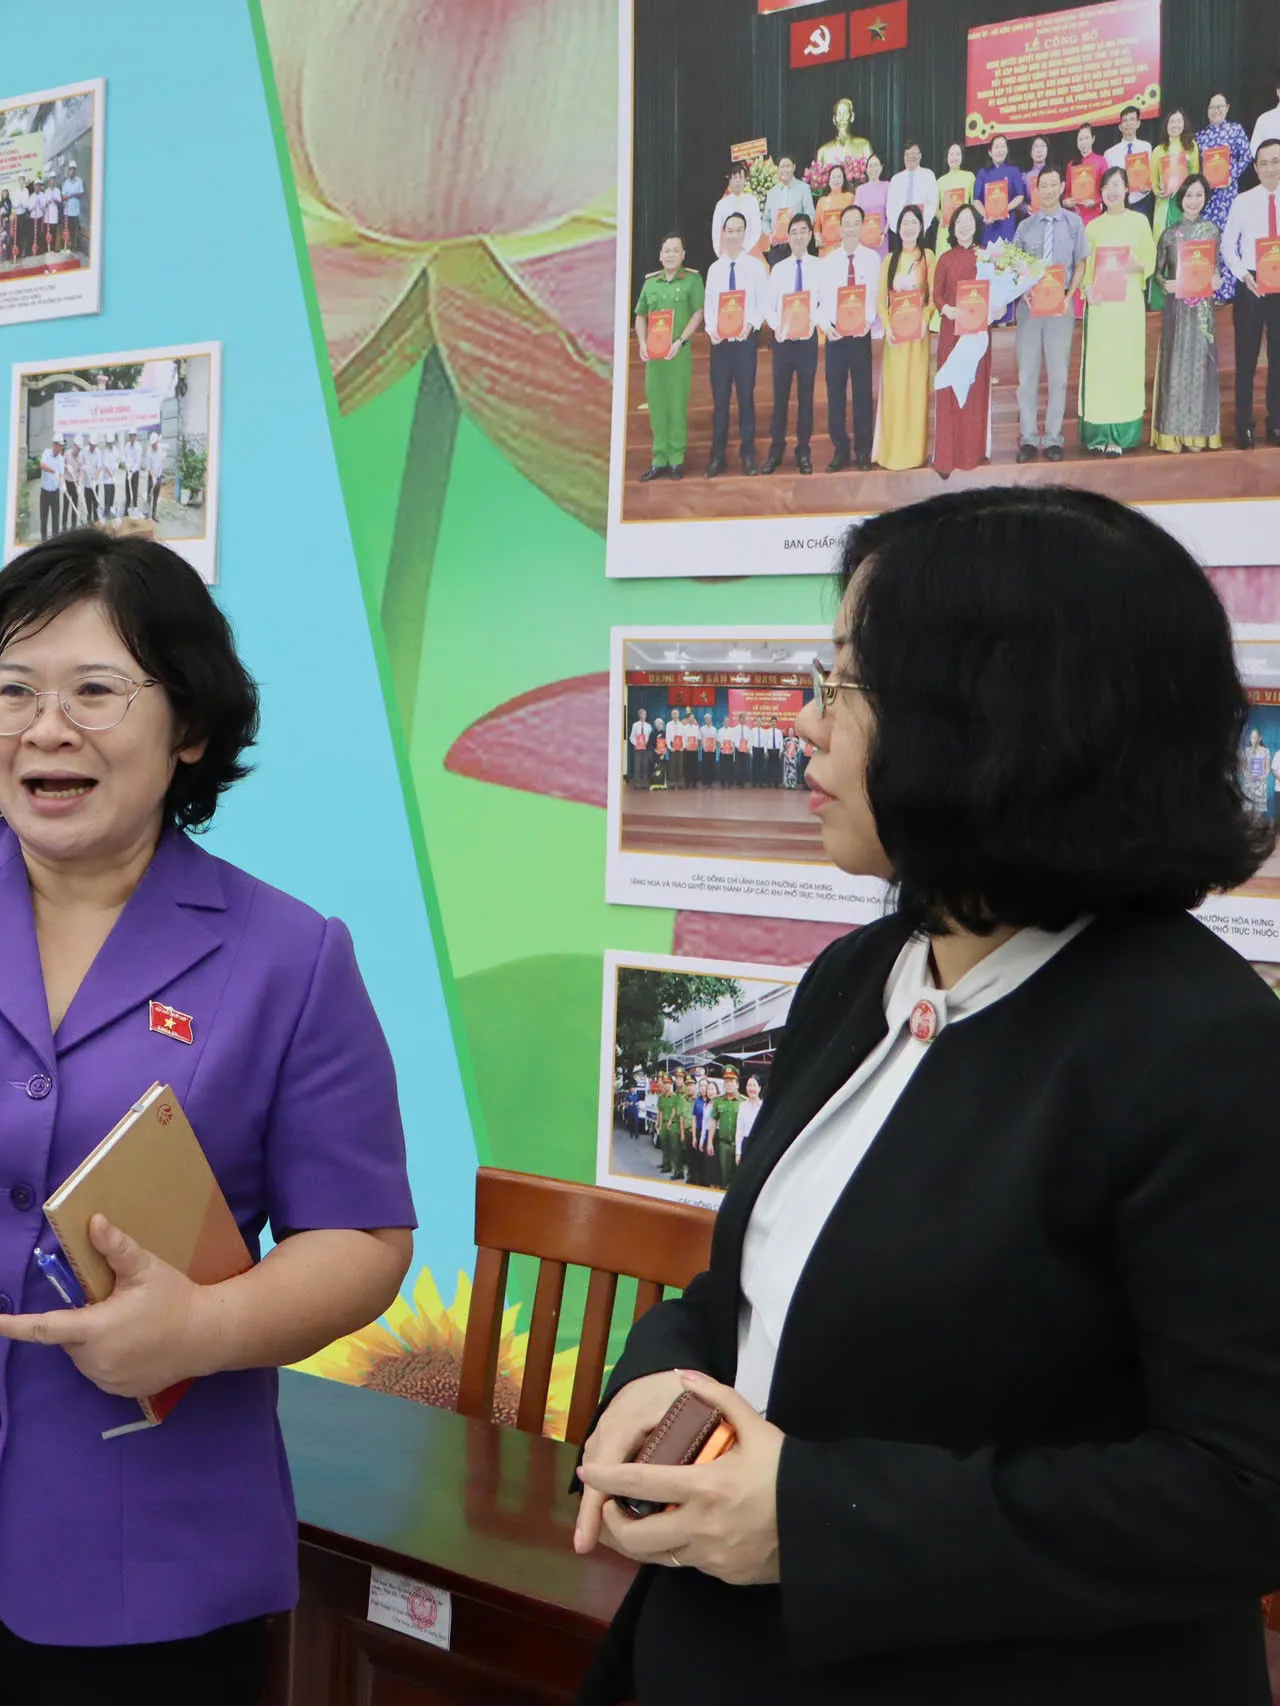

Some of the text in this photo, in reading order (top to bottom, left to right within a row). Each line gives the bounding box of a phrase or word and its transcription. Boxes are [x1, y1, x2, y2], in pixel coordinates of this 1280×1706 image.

[783, 539, 804, 550] BAN
[806, 535, 835, 550] CHẤP
[1231, 916, 1249, 925] HÒA
[1251, 918, 1275, 927] HƯNG
[1212, 924, 1280, 938] PHỐ TRỰC THUỘC
